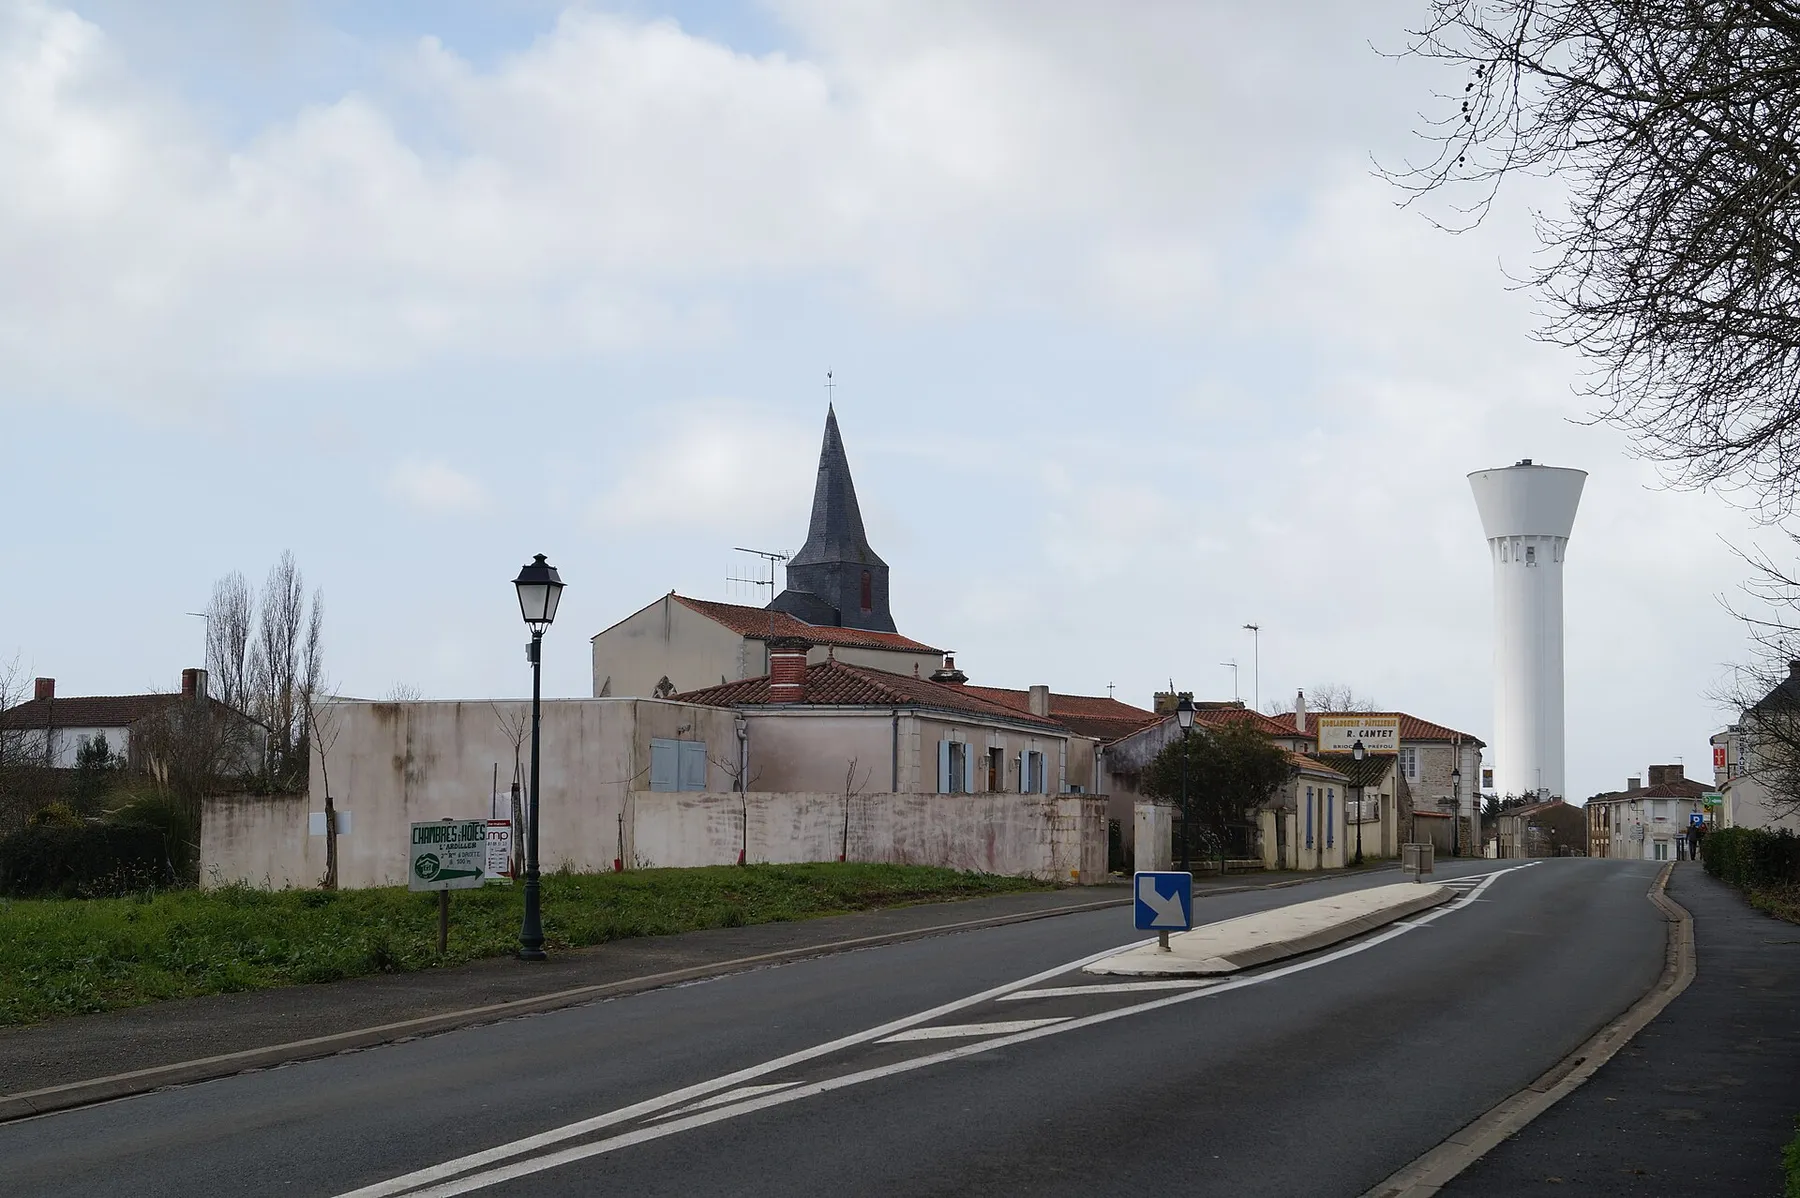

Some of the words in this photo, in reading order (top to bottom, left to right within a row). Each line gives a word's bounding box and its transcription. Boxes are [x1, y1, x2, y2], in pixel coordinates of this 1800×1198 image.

[1347, 730, 1356, 738] R.
[1359, 730, 1393, 738] CANTET
[413, 825, 457, 844] CHAMBRES
